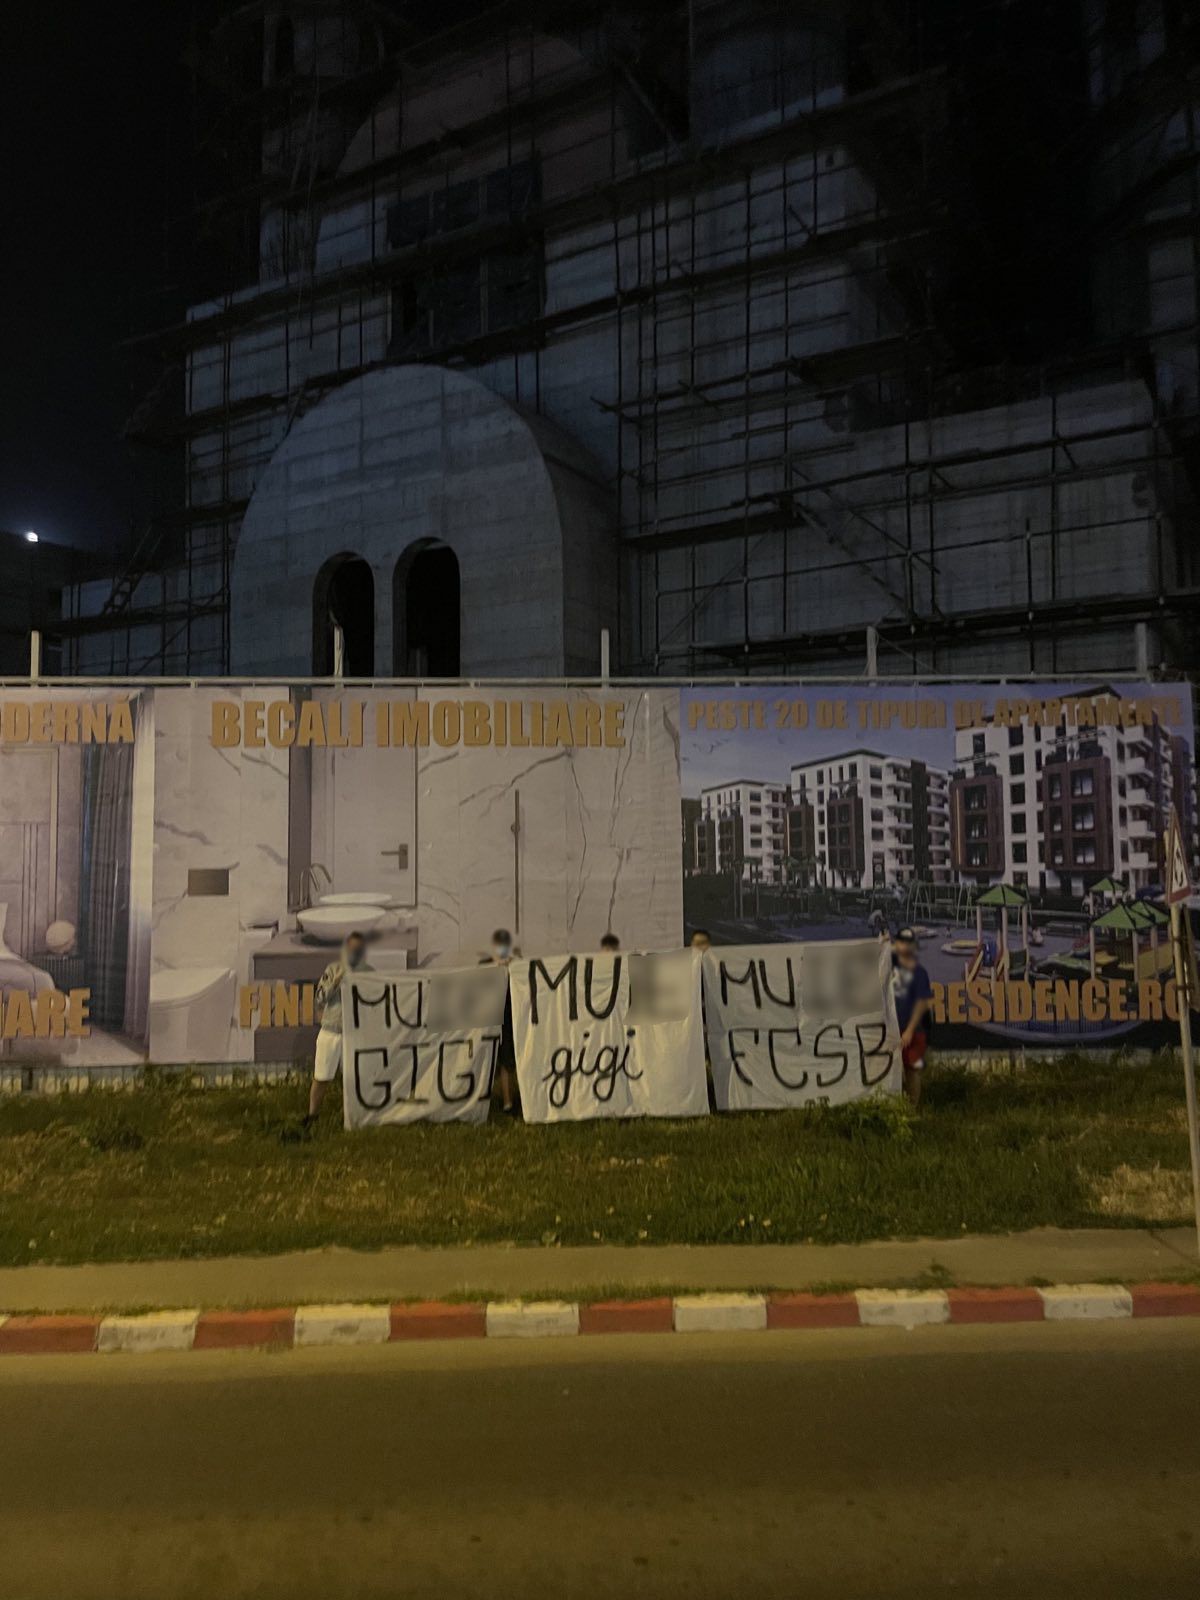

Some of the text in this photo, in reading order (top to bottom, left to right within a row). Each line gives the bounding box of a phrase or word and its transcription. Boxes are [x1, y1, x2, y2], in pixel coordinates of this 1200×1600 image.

[211, 700, 626, 748] BECALI IMOBILIARE
[687, 697, 1186, 730] PESTE 20 DE TIPURI DE APARTAMENTE
[352, 980, 426, 1029] MU
[529, 956, 632, 1025] MU
[720, 957, 801, 1009] MU
[0, 987, 92, 1038] ARE
[354, 1033, 500, 1110] GIGI
[542, 1030, 644, 1108] gigi
[728, 1022, 893, 1090] FCSB
